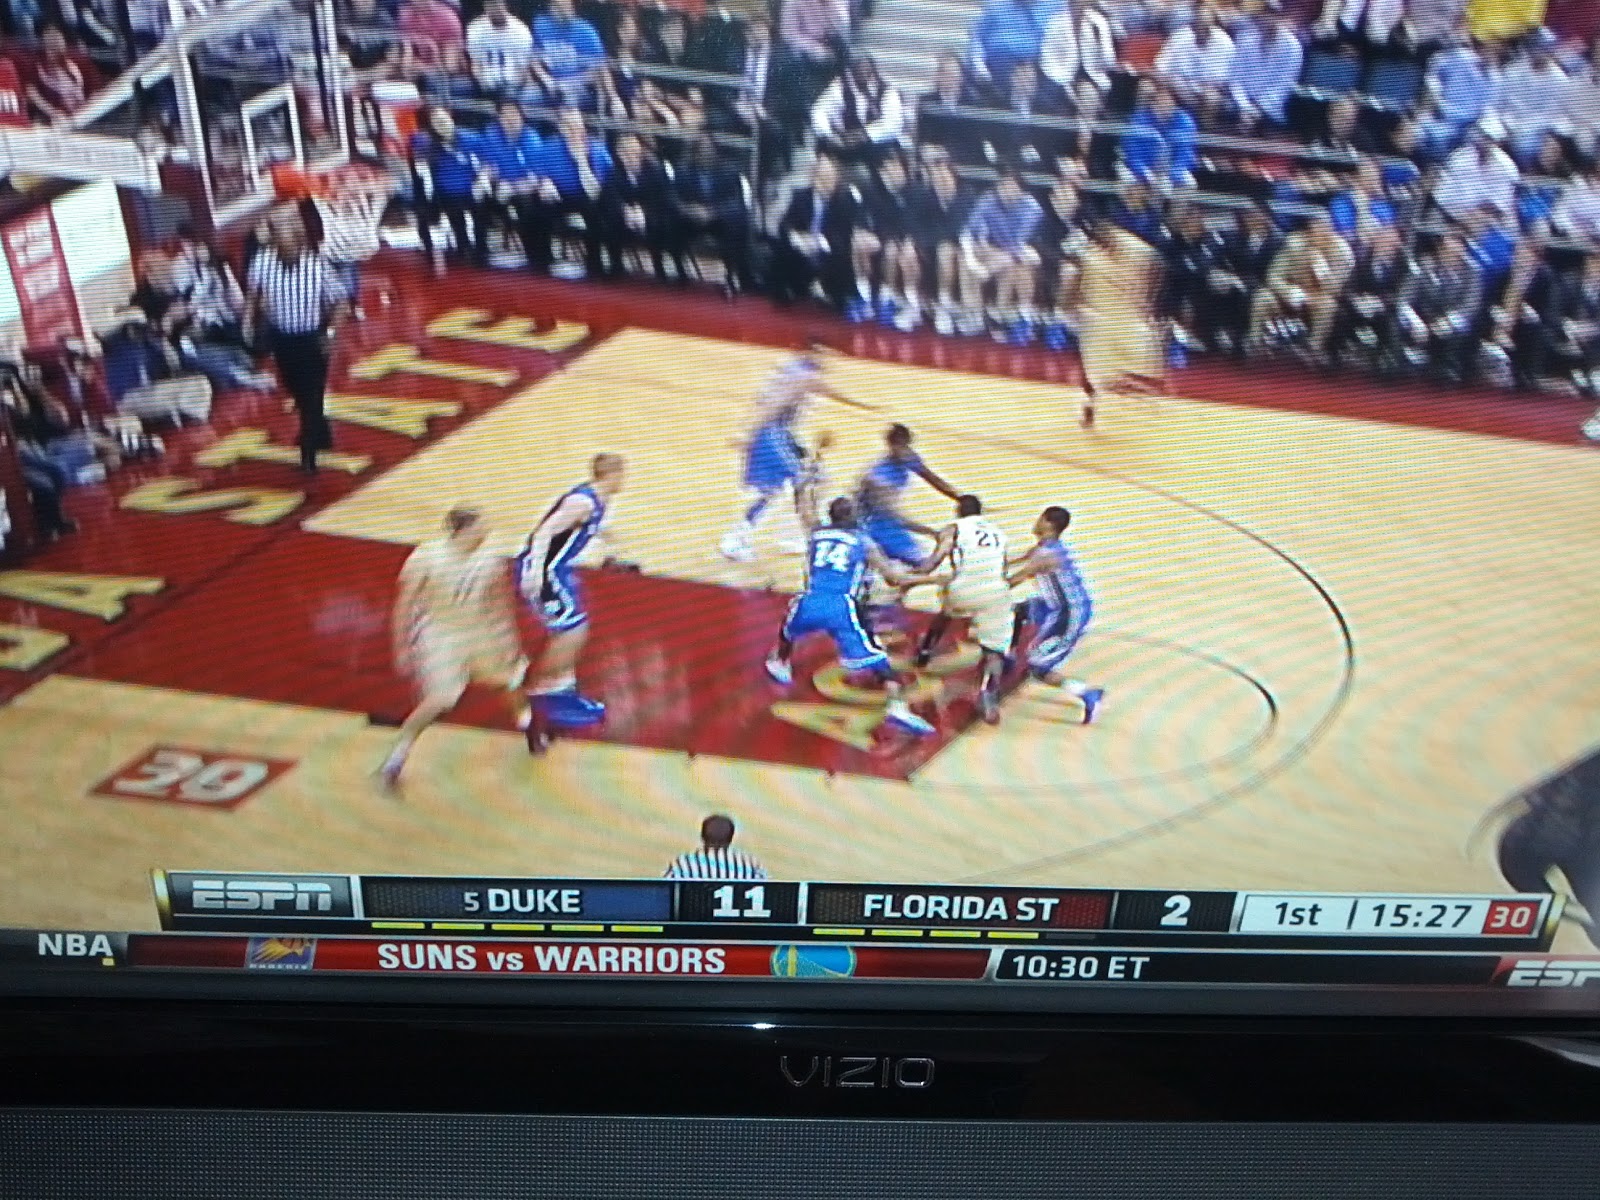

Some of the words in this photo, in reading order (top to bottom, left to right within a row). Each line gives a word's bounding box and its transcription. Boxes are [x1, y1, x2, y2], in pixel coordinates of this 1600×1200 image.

[192, 879, 332, 911] ESPN
[463, 891, 480, 912] 5
[487, 887, 581, 914] DUKE
[712, 885, 772, 918] 11
[863, 894, 1008, 920] FLORIDA
[1015, 897, 1060, 922] ST
[1160, 894, 1192, 926] 2
[1275, 902, 1322, 926] 1st
[1372, 903, 1472, 928] 15:27
[1489, 905, 1531, 928] 30
[38, 933, 114, 957] NBA
[377, 943, 477, 970] SUNS
[487, 951, 525, 972] vs
[533, 945, 726, 974] WARRIORS
[1012, 955, 1099, 979] 10:30
[1107, 956, 1150, 980] ET
[780, 1055, 935, 1088] VIZIO
